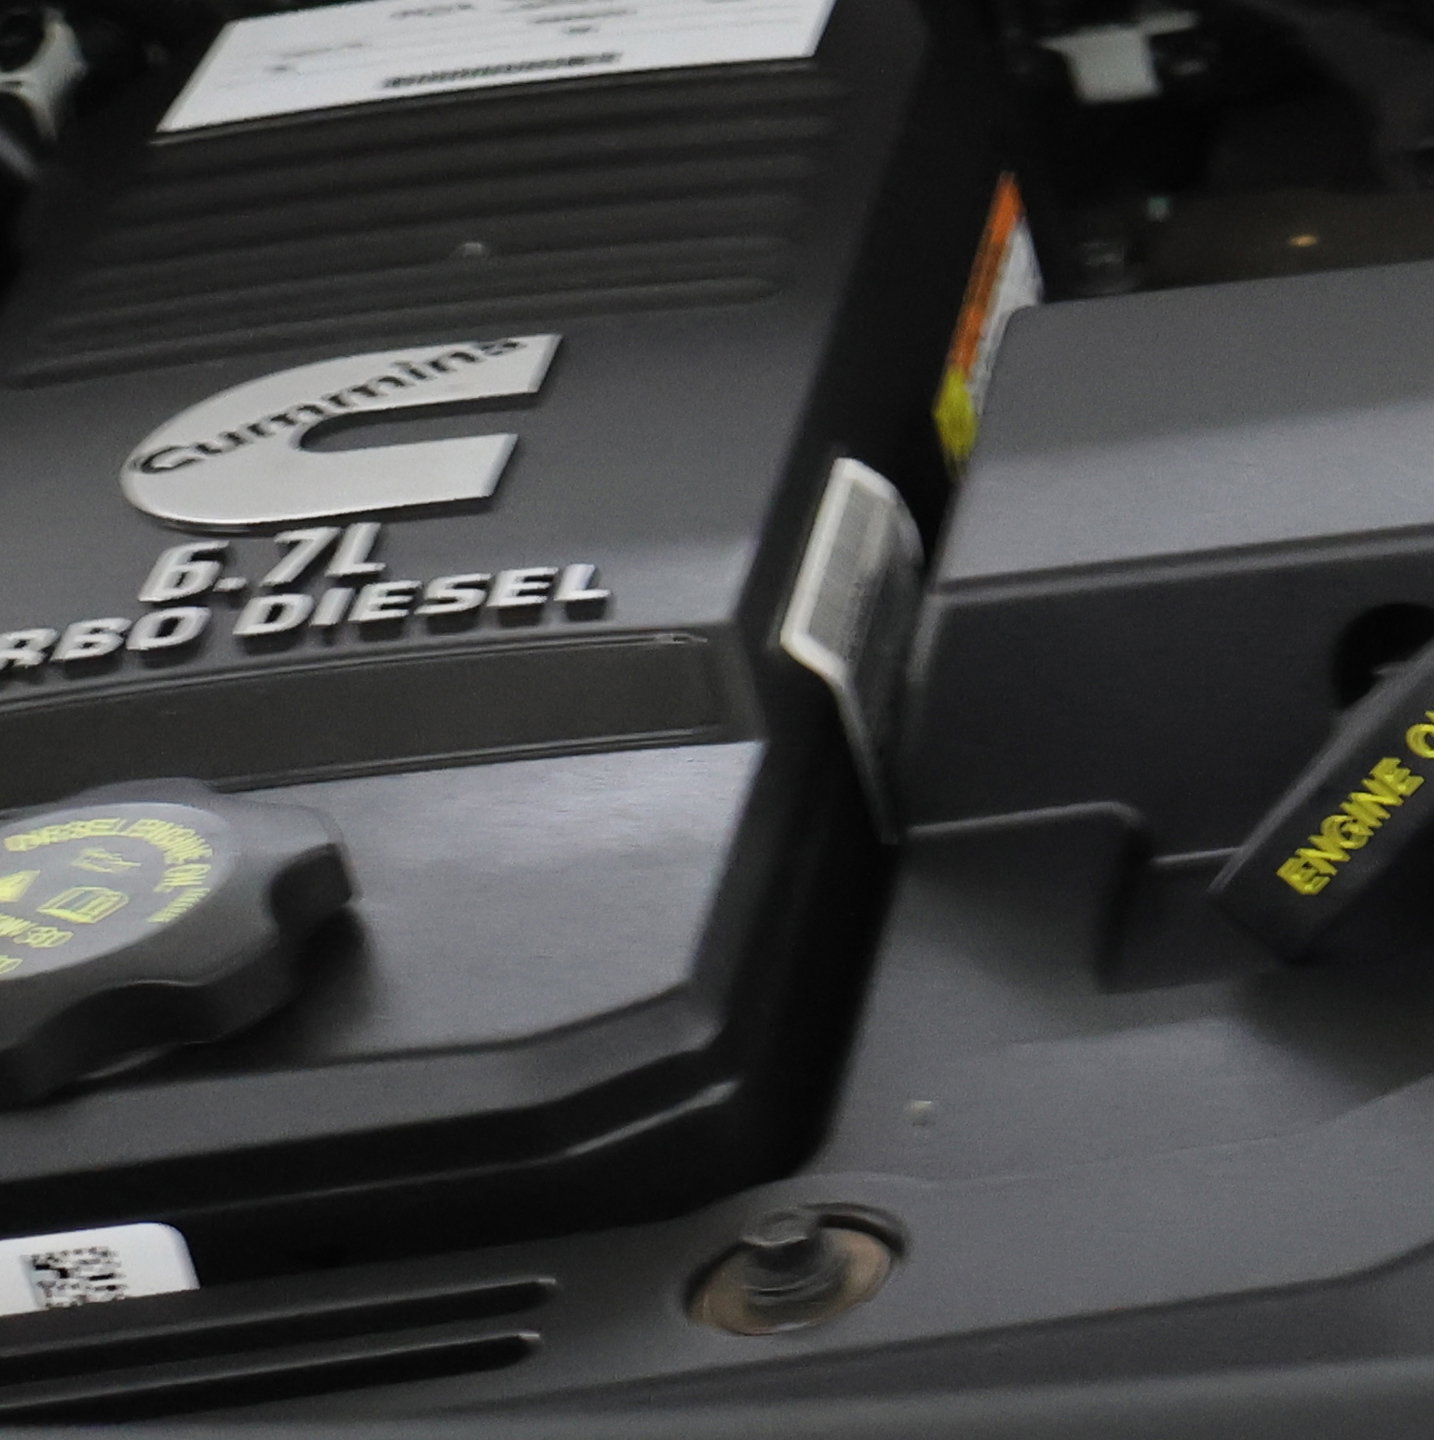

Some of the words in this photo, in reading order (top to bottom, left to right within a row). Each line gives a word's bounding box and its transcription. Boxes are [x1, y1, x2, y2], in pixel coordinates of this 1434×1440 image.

[134, 337, 526, 474] Cummins
[138, 522, 387, 603] 6.7L
[233, 563, 612, 637] DIESEL
[1276, 757, 1425, 895] ENGINE
